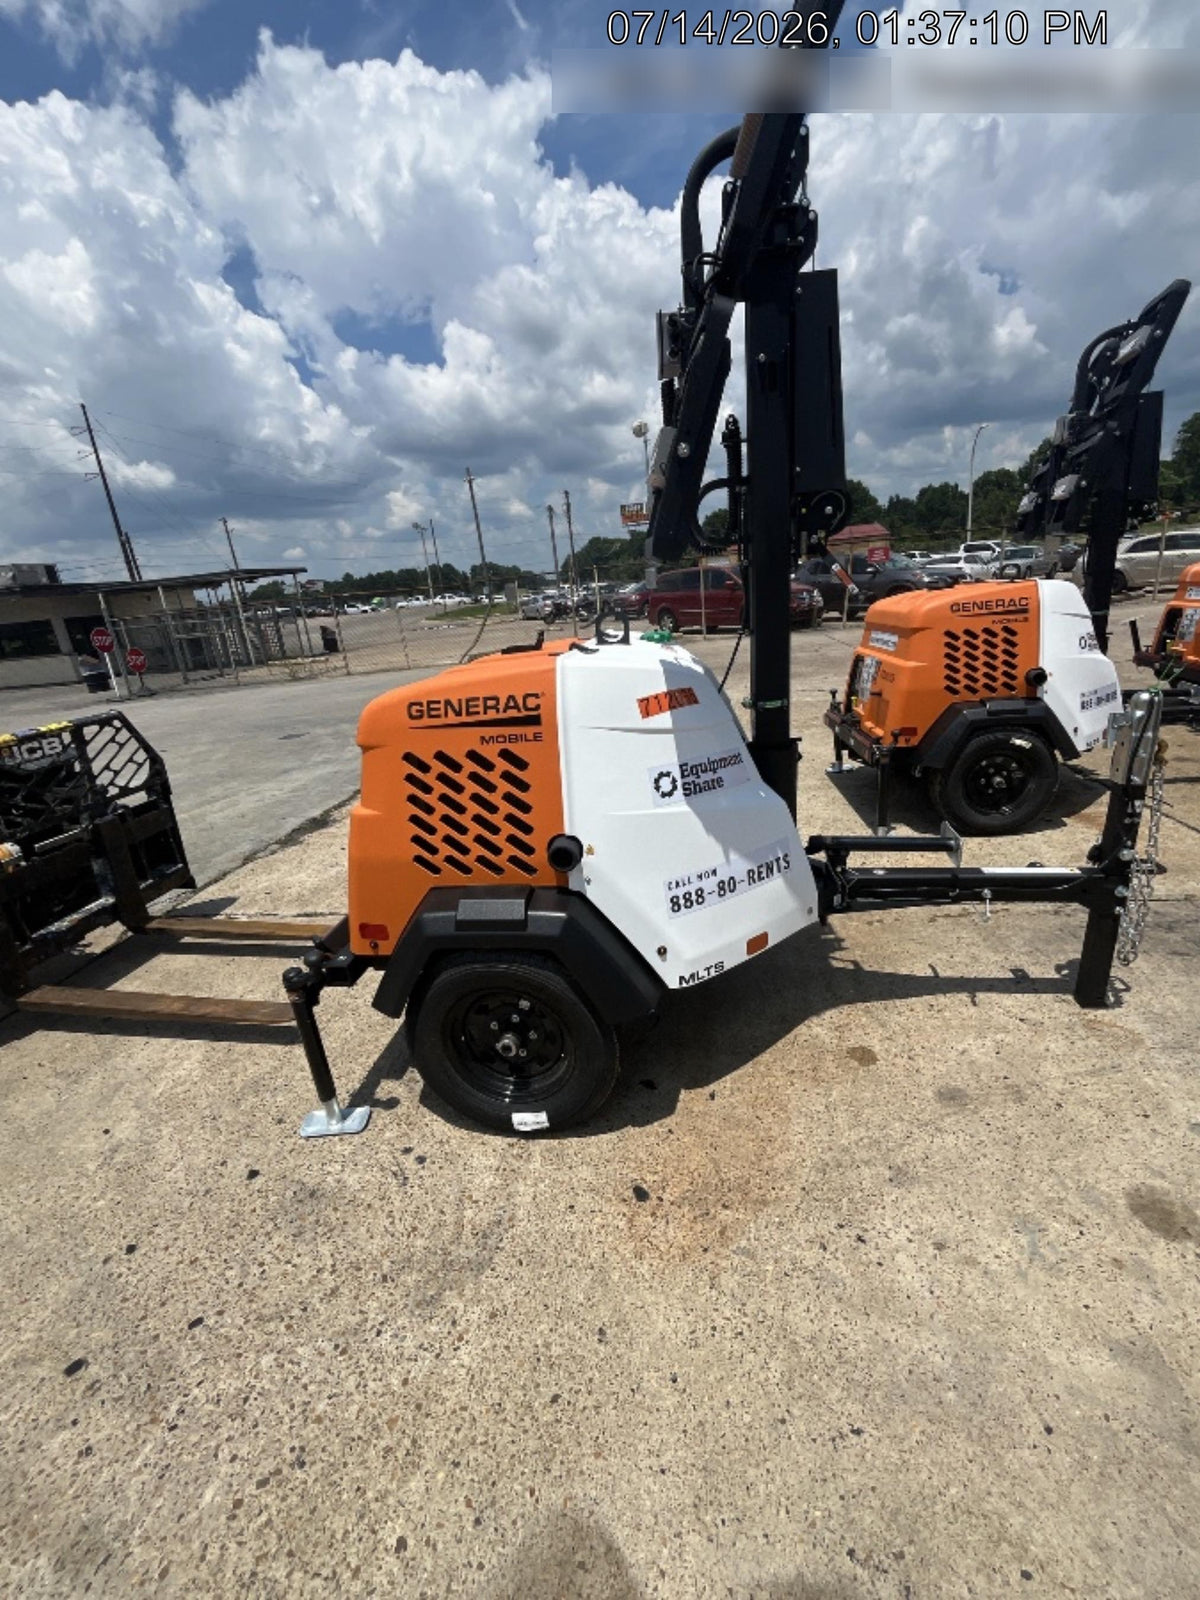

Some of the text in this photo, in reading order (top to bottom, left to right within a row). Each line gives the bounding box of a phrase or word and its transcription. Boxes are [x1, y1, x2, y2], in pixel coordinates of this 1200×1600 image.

[950, 597, 1030, 614] GENERAC
[407, 693, 541, 720] GENERAC
[4, 737, 63, 766] JCB
[480, 732, 543, 745] MOBILE
[679, 752, 744, 779] Equipment
[682, 776, 724, 797] Share
[668, 867, 717, 891] CALL NOW
[669, 853, 790, 913] 888-80-RENTS
[678, 961, 725, 987] MLTS
